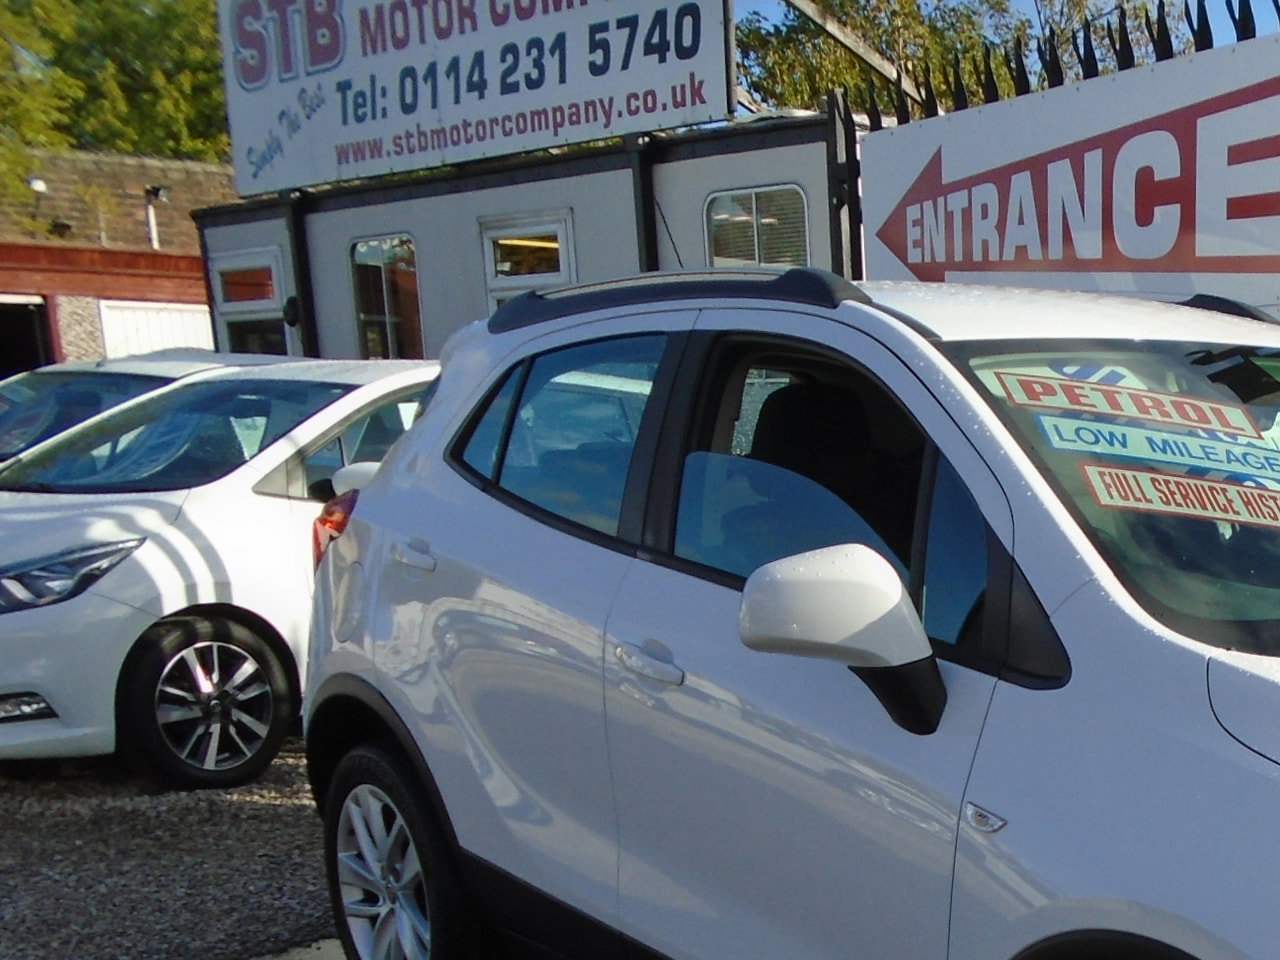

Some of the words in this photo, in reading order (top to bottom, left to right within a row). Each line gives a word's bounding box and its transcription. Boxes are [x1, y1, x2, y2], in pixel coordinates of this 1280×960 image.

[232, 0, 346, 92] STB
[358, 0, 478, 57] MOTOR
[336, 74, 388, 126] Tel:
[400, 51, 488, 115] 0114
[500, 31, 567, 95] 231
[588, 2, 701, 78] 5740
[335, 71, 708, 166] www.stbmotorcompany.co.uk
[1016, 378, 1246, 432] PETROL
[1051, 423, 1128, 450] LOW
[1097, 470, 1154, 505] FULL
[1150, 476, 1241, 516] SERVICE
